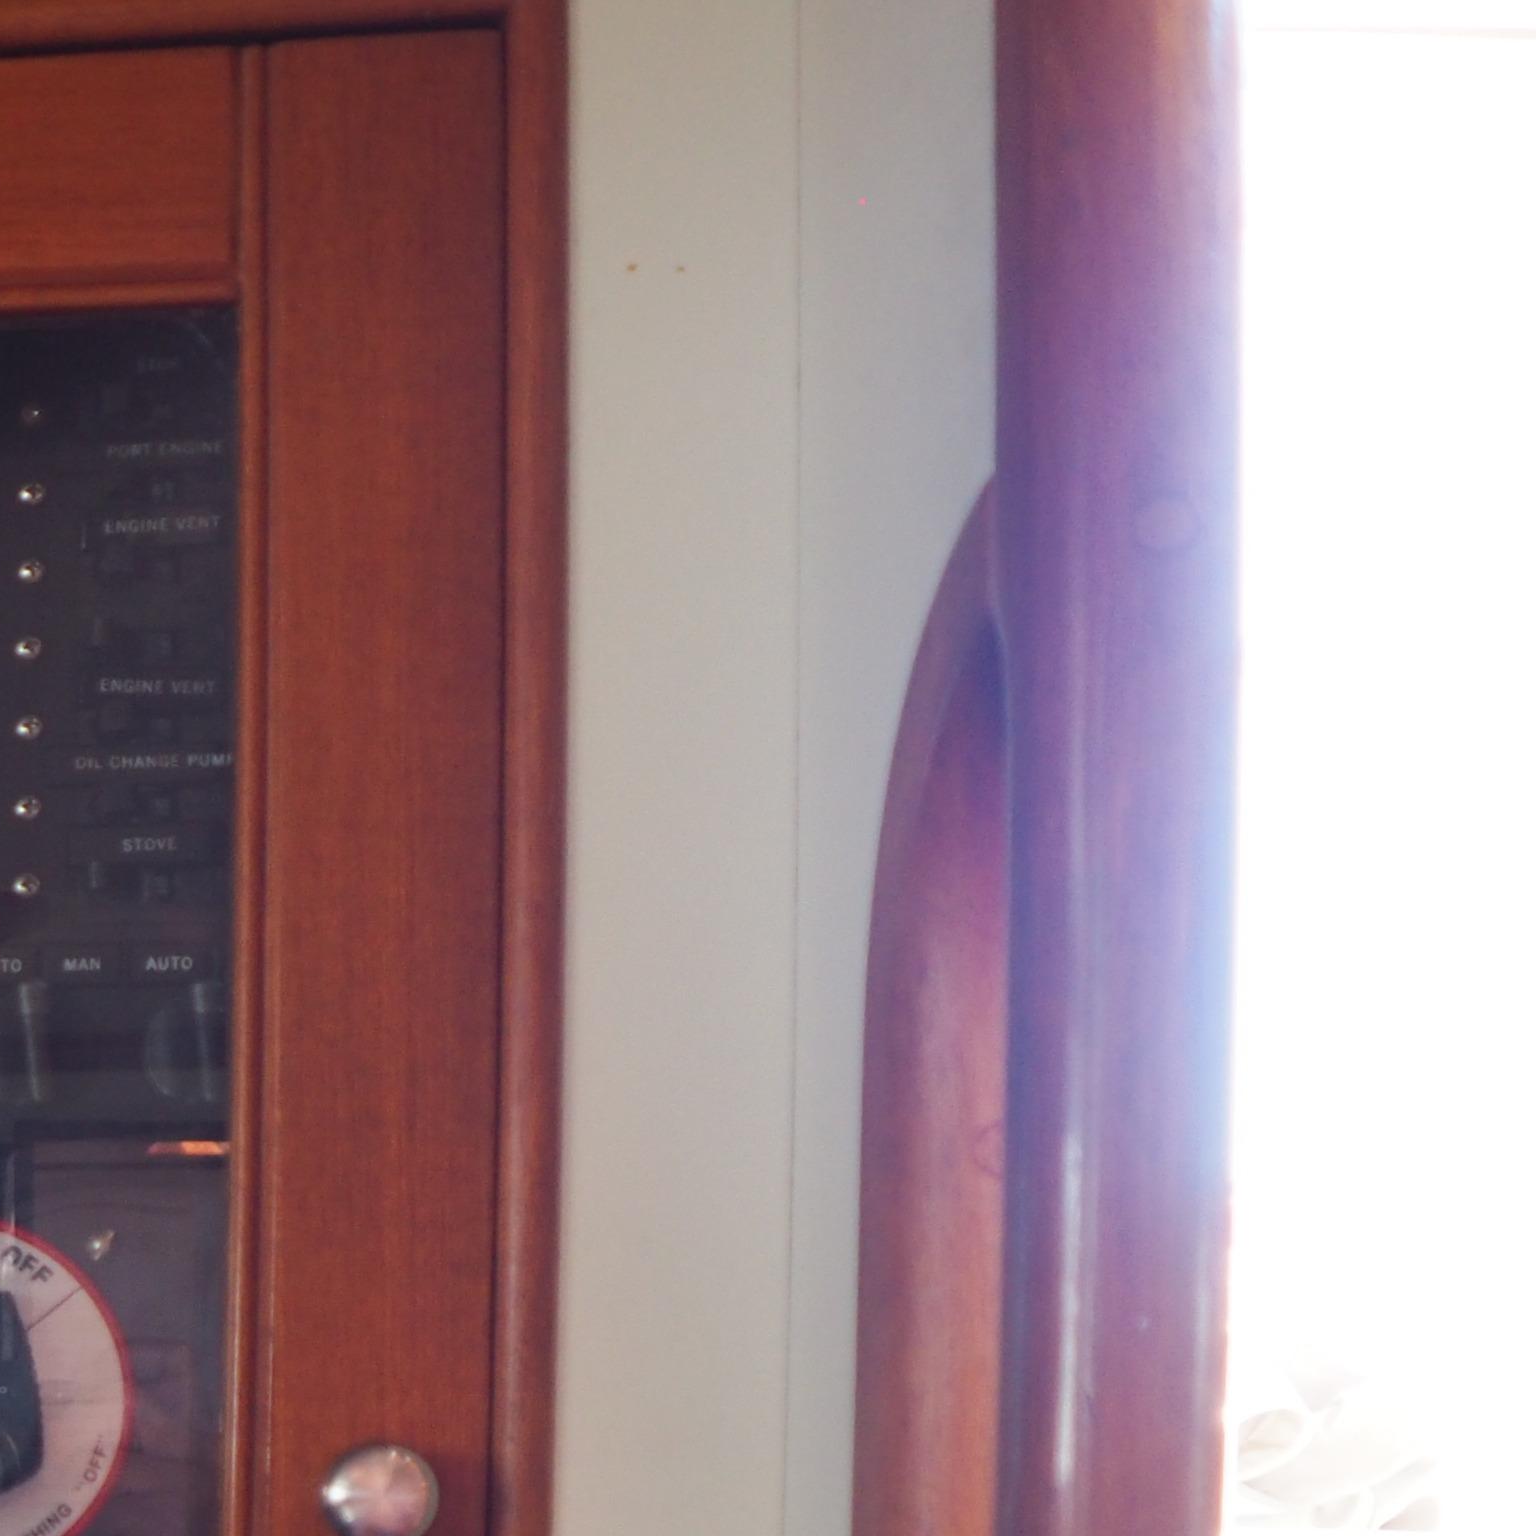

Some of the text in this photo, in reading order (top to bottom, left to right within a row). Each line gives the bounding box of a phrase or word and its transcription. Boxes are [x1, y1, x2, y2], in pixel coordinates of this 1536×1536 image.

[103, 514, 221, 534] ENGINE VENT
[99, 677, 216, 695] ENGINE VENT
[75, 756, 103, 770] OIL
[108, 754, 180, 770] CHANGE
[122, 835, 177, 853] STOVE
[63, 957, 102, 972] MAN
[145, 956, 194, 972] AUTO
[0, 1244, 54, 1284] OFF
